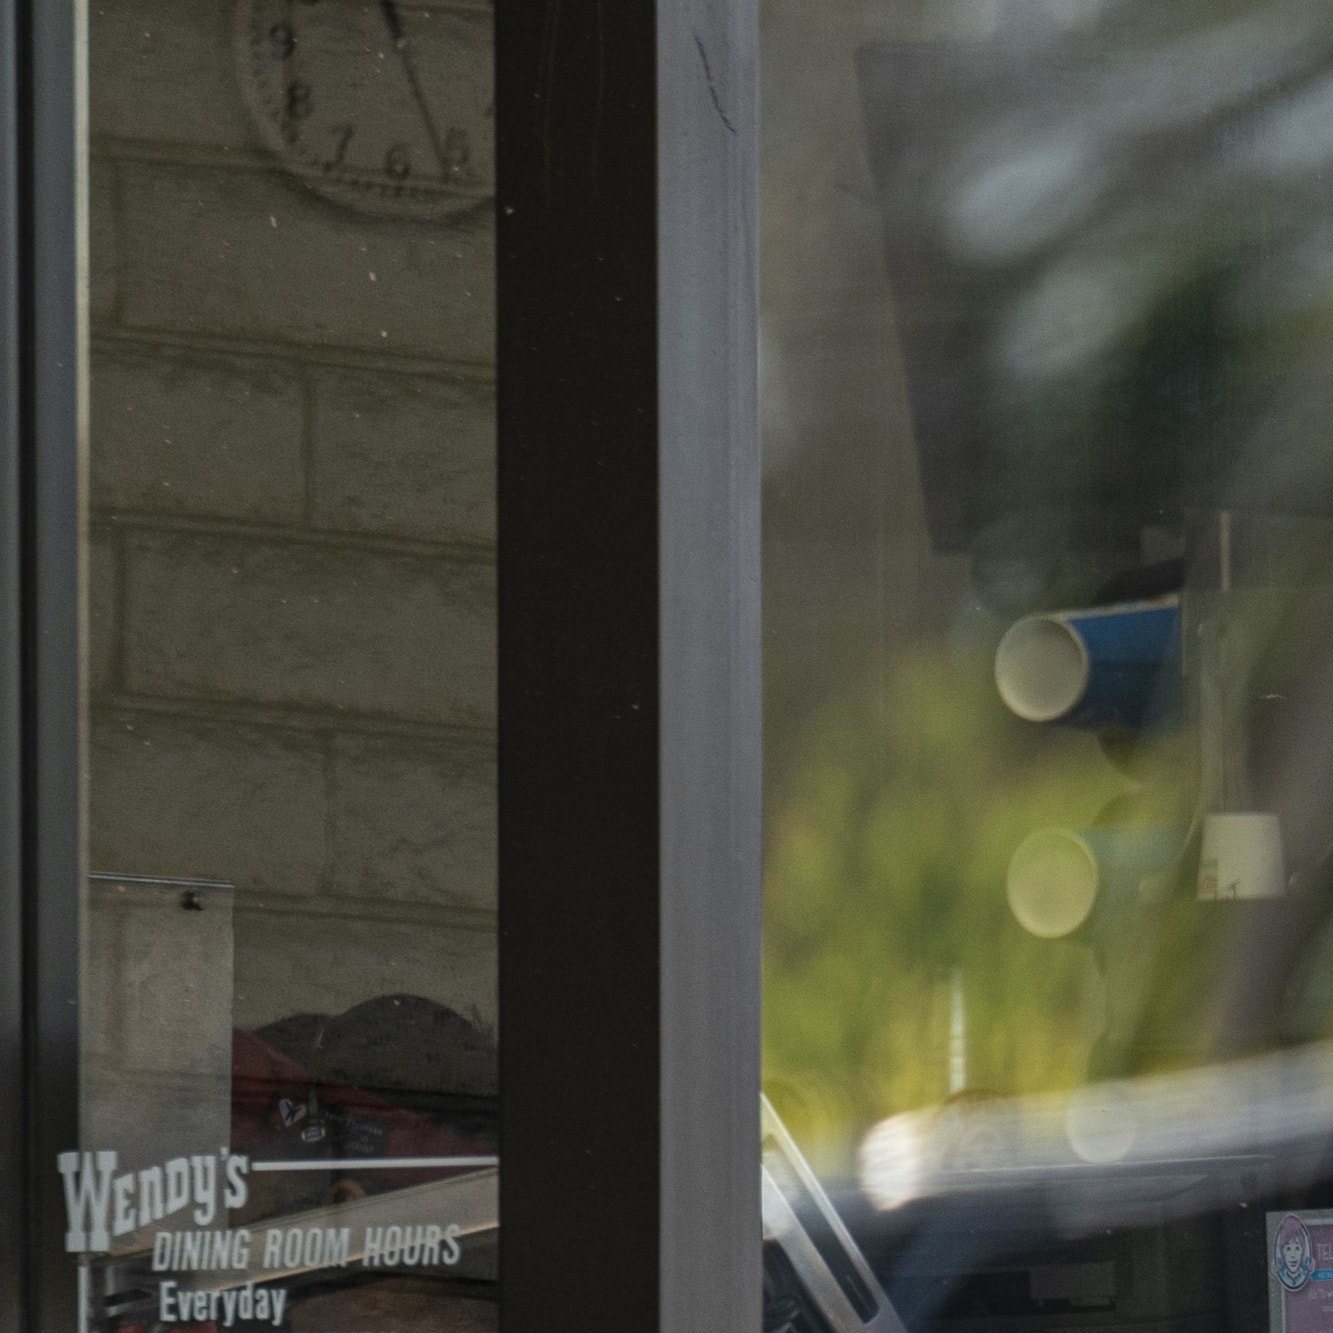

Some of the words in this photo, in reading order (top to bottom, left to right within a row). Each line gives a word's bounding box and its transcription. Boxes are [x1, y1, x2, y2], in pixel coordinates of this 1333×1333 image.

[152, 1232, 251, 1272] DINING
[263, 1229, 350, 1269] ROOM
[363, 1225, 462, 1266] HOURS
[159, 1281, 287, 1328] Everyday
